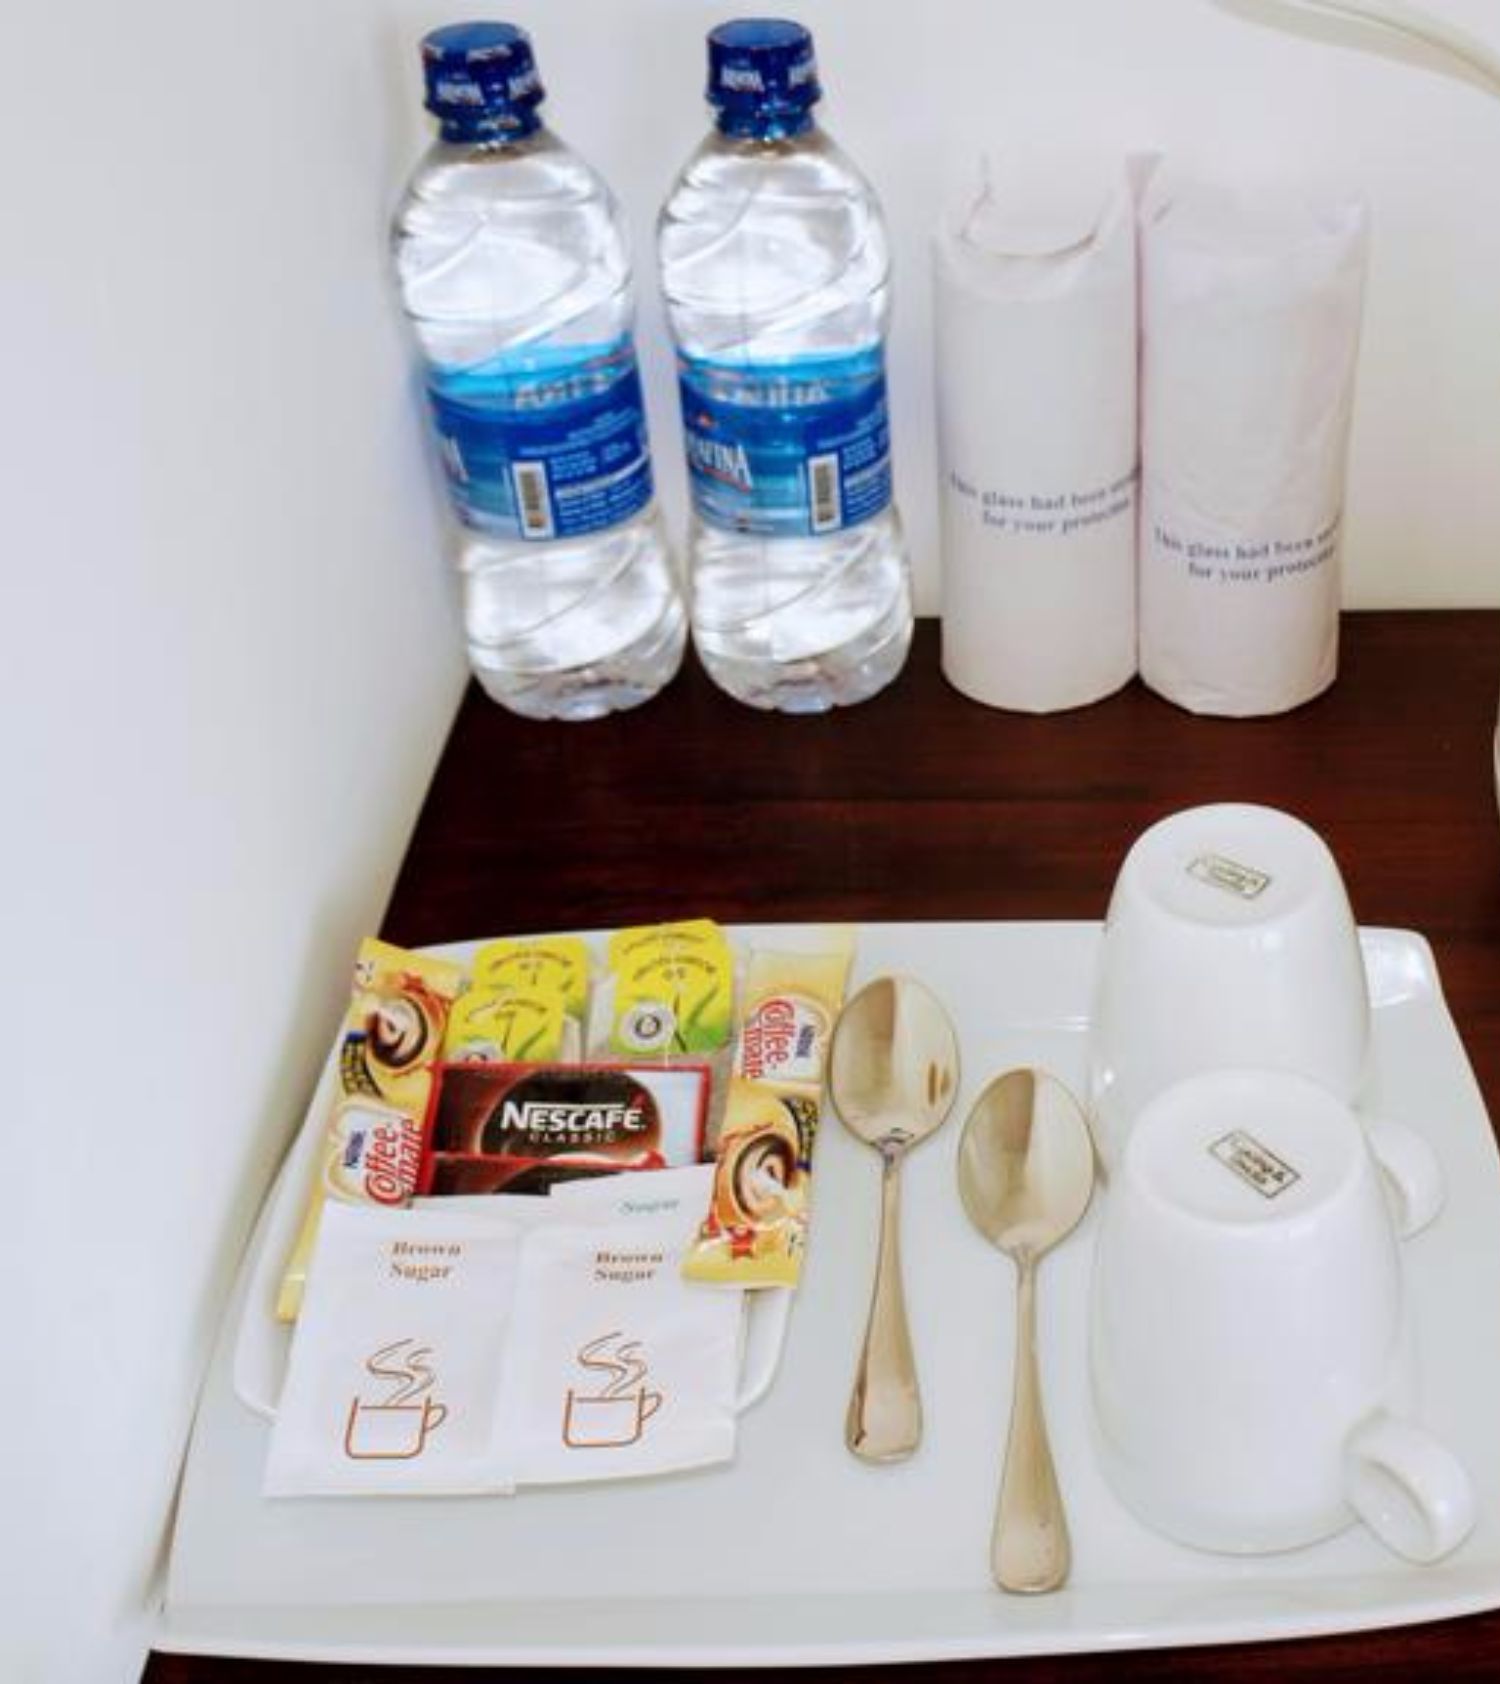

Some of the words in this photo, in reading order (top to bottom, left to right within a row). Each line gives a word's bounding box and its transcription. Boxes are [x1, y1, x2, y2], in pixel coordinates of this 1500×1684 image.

[981, 491, 1024, 511] glass
[1031, 495, 1065, 511] had
[983, 510, 1006, 526] for
[1013, 519, 1055, 534] your
[1187, 543, 1231, 561] glass
[1236, 544, 1270, 560] had
[1189, 561, 1212, 579] for
[1220, 568, 1259, 582] your
[392, 1241, 462, 1256] Brown
[596, 1253, 663, 1263] Brown
[389, 1264, 452, 1282] Sugar
[595, 1269, 654, 1284] Sugar
